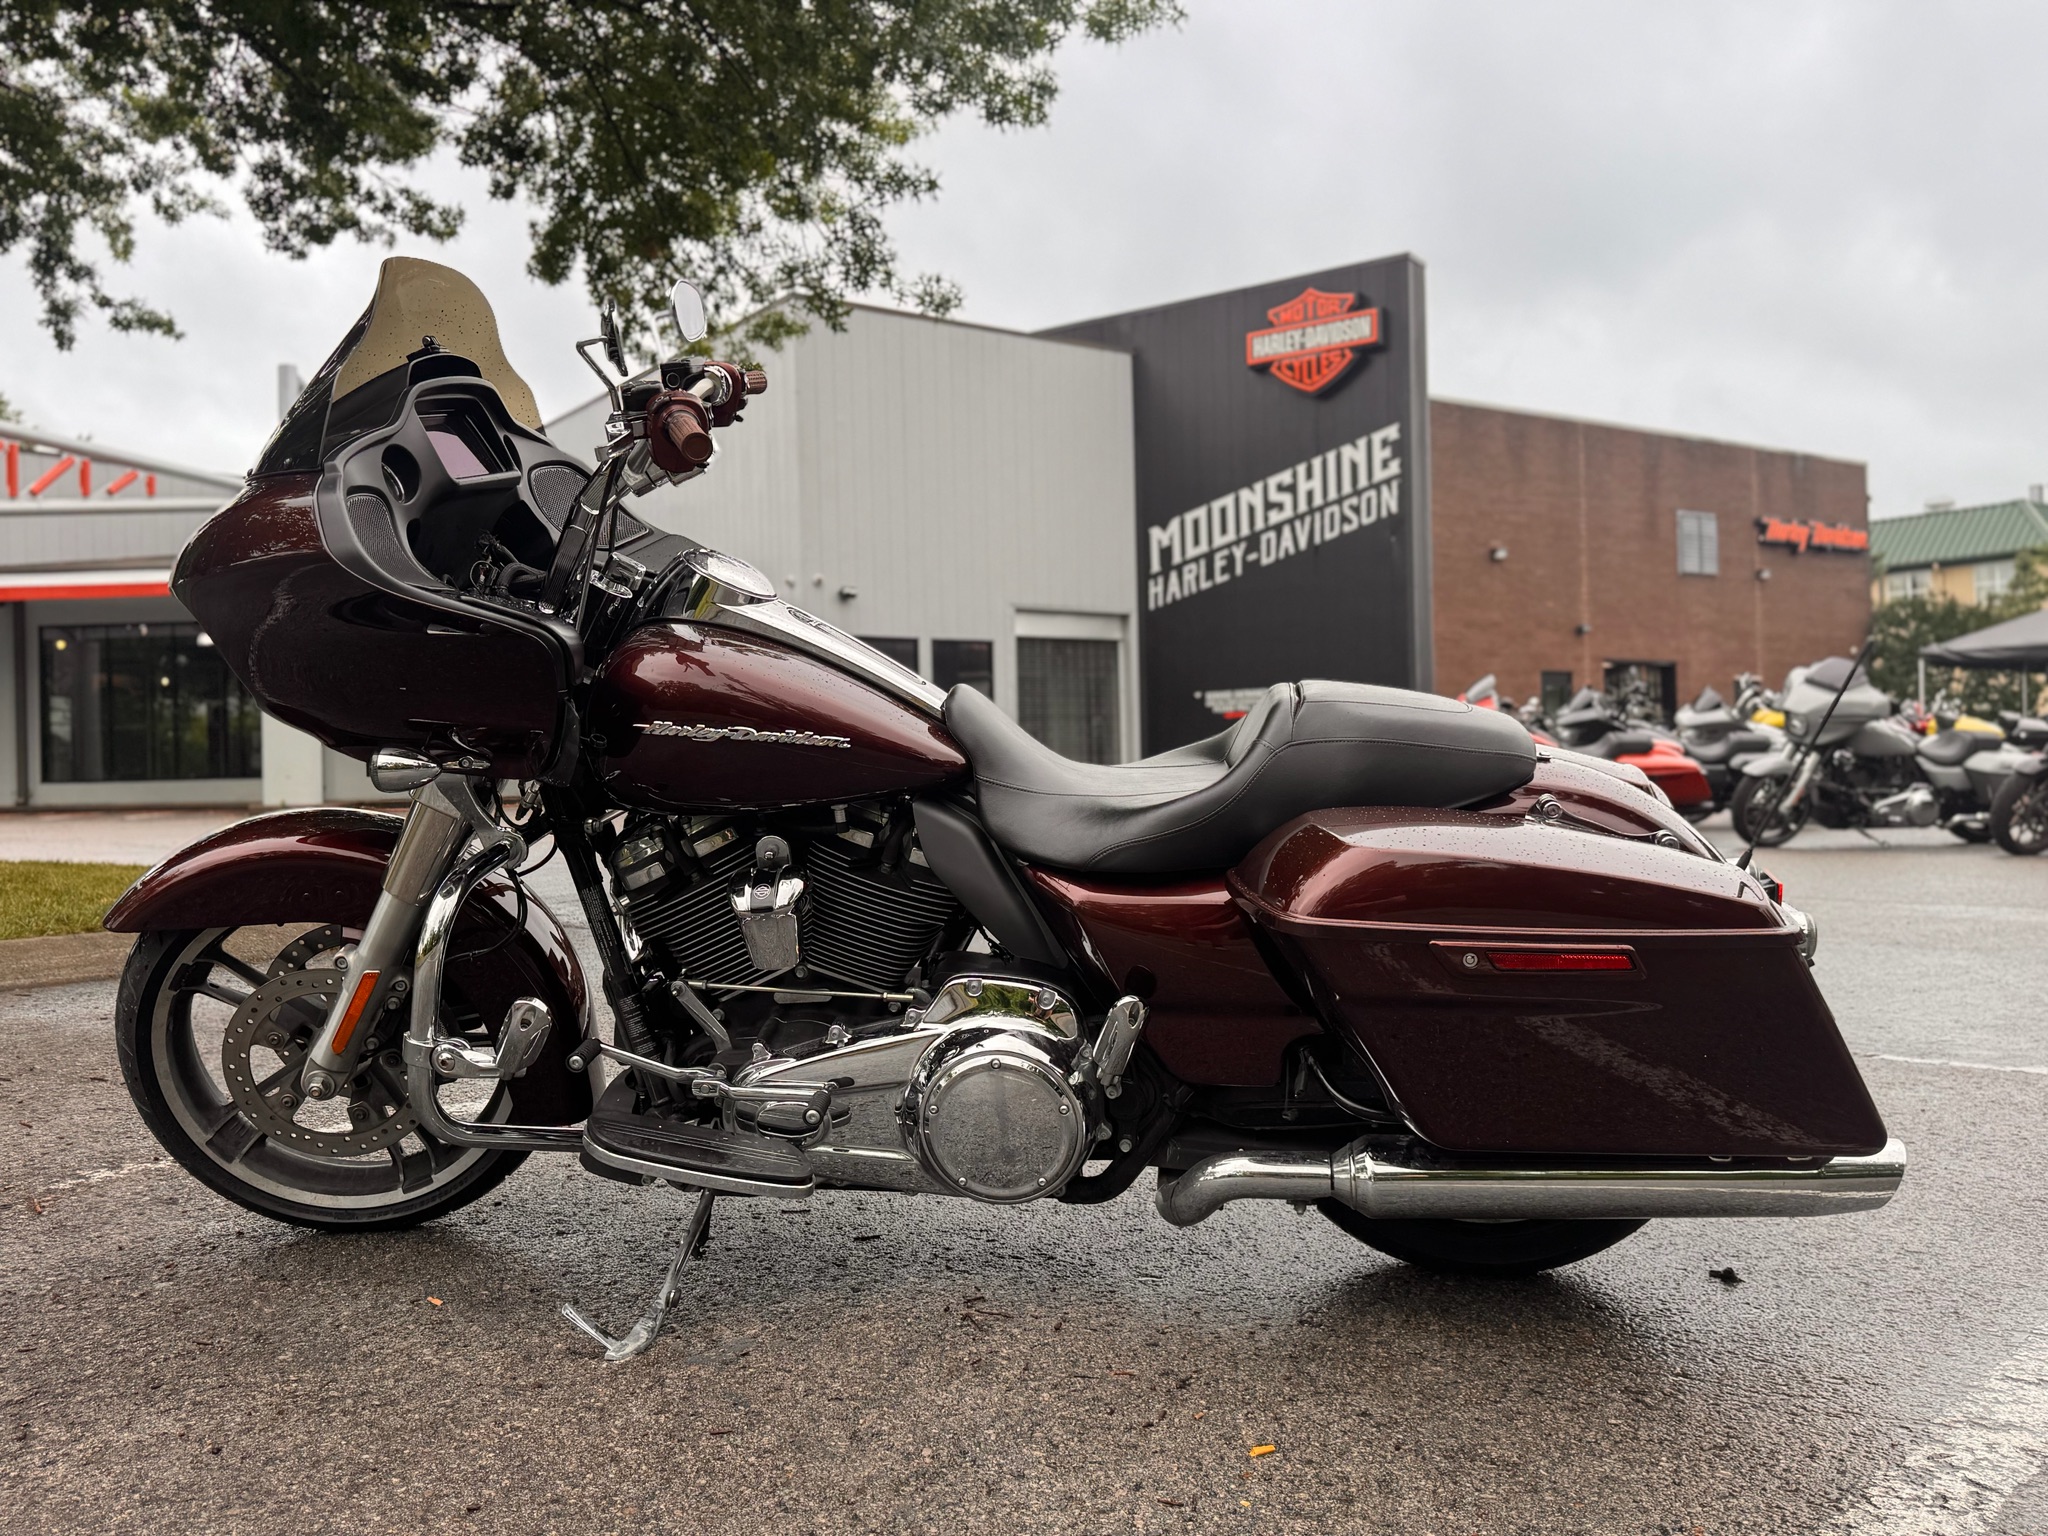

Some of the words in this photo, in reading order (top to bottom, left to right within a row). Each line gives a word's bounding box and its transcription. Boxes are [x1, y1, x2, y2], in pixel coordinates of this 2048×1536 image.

[1278, 299, 1342, 323] MOTOR
[1252, 315, 1371, 359] HARLEY-DAVIDSON
[1280, 350, 1343, 384] CYCLES
[1148, 422, 1401, 575] MOONSHINE
[1148, 479, 1401, 611] HARLEY-DAVIDSON
